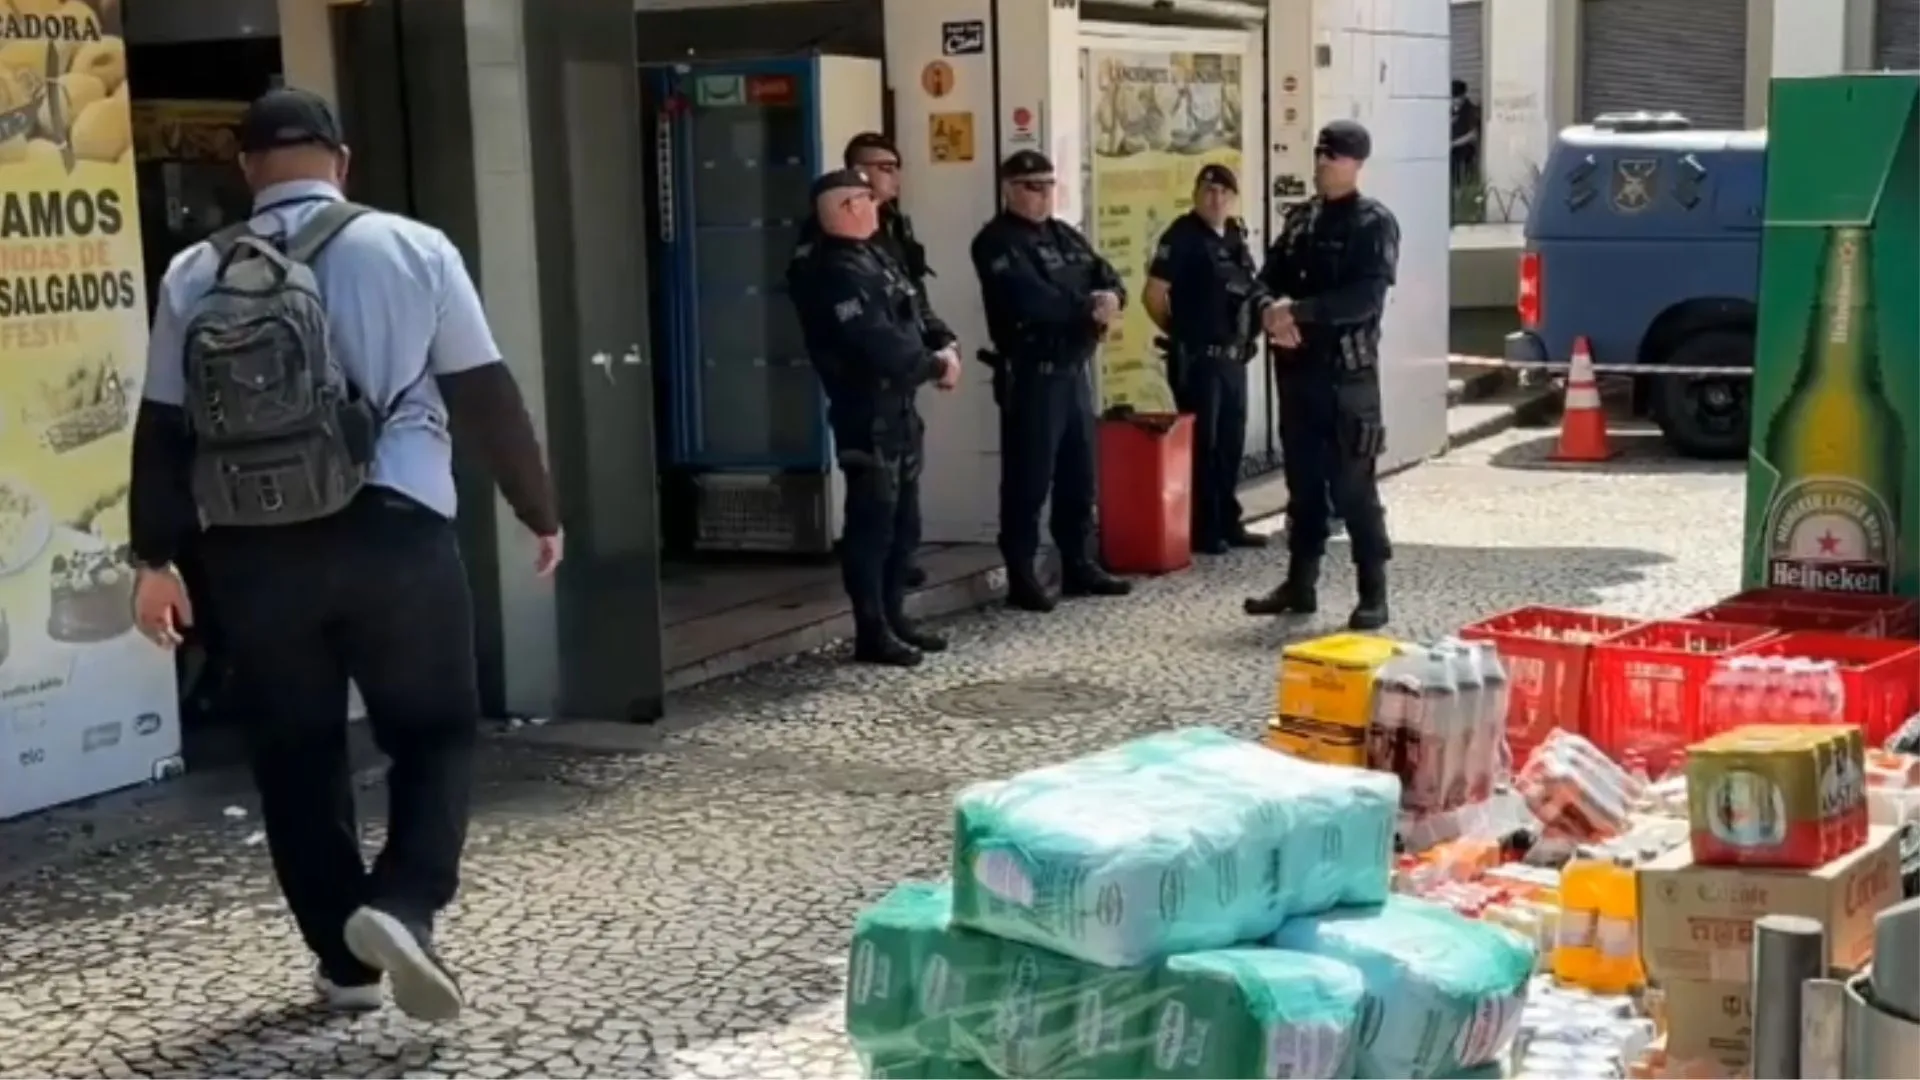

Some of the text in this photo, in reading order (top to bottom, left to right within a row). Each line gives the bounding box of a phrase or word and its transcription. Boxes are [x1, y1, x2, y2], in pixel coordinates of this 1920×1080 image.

[0, 13, 101, 41] ADORA
[0, 187, 123, 238] AMOS
[78, 239, 112, 268] DE
[0, 269, 135, 317] SALGADOS
[1, 317, 80, 350] FESTA
[1772, 561, 1881, 592] Heineken
